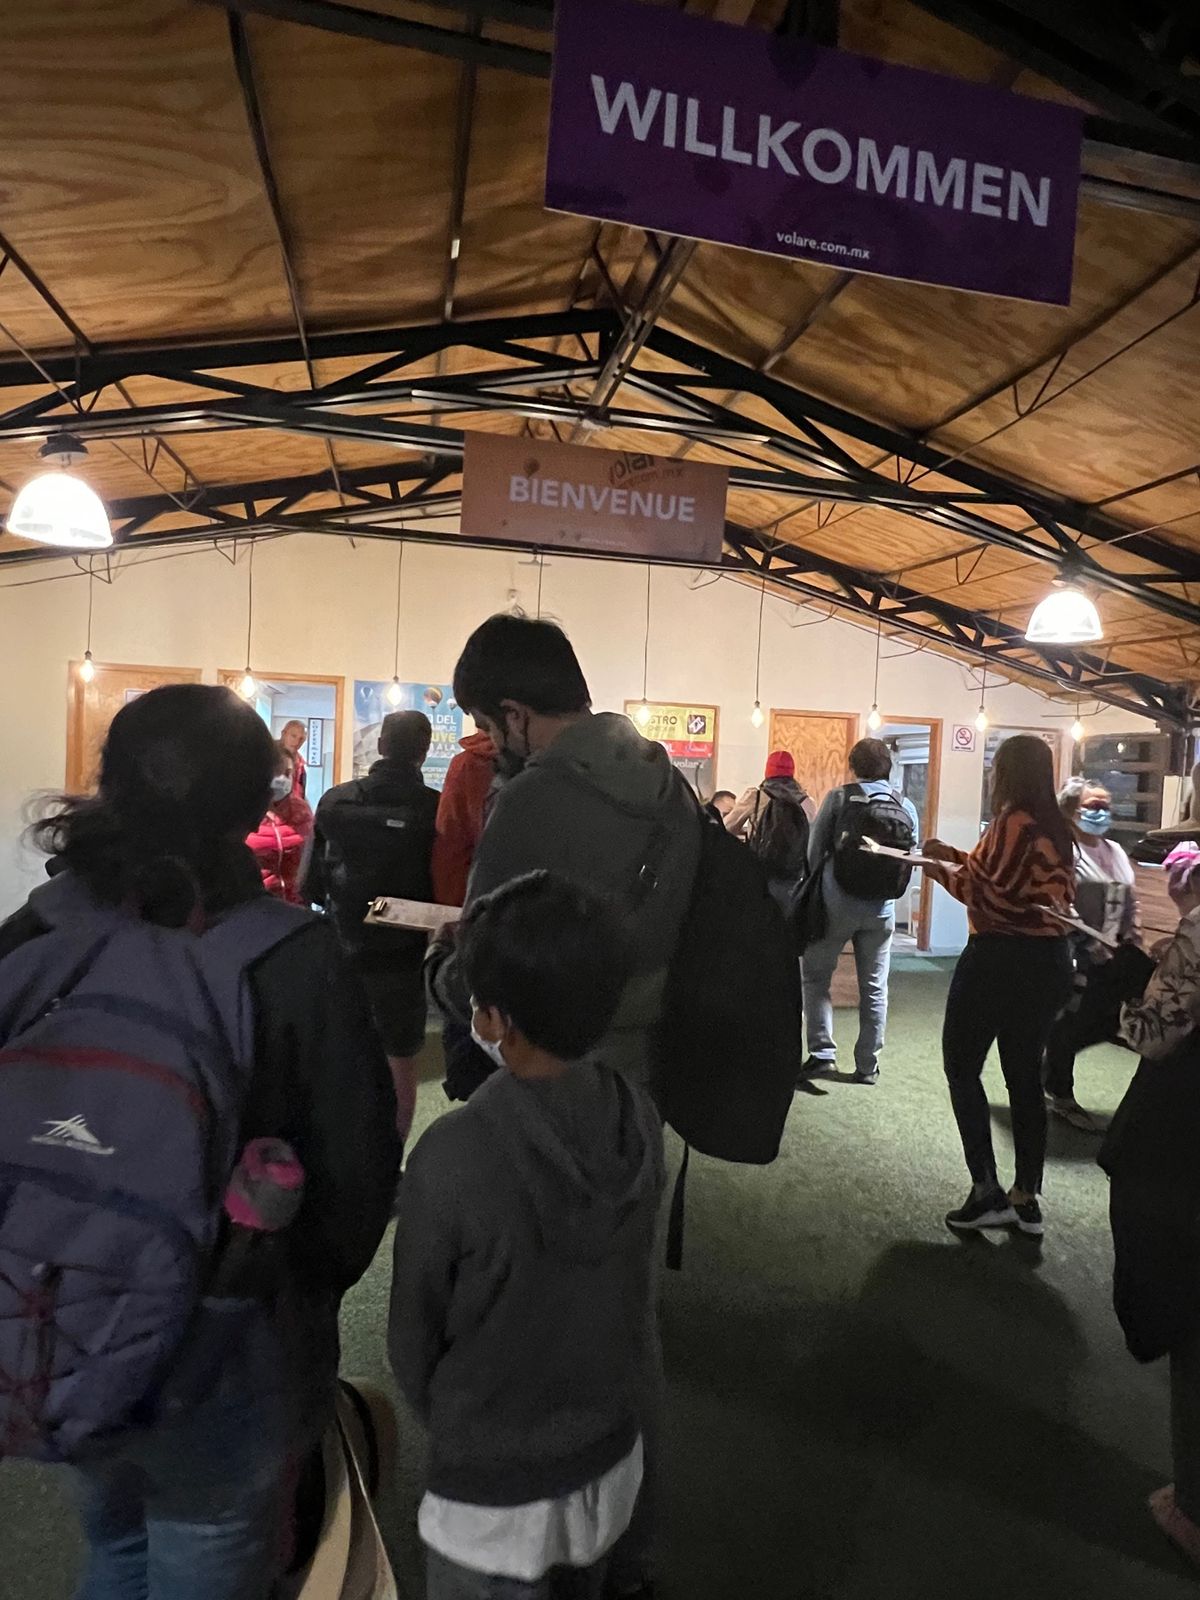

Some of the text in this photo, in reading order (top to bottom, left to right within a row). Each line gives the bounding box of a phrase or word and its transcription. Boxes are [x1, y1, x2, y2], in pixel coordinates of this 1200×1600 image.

[591, 74, 1051, 227] WILLKOMMEN
[776, 231, 871, 261] volare.com.mx
[509, 475, 695, 522] BIENVENUE
